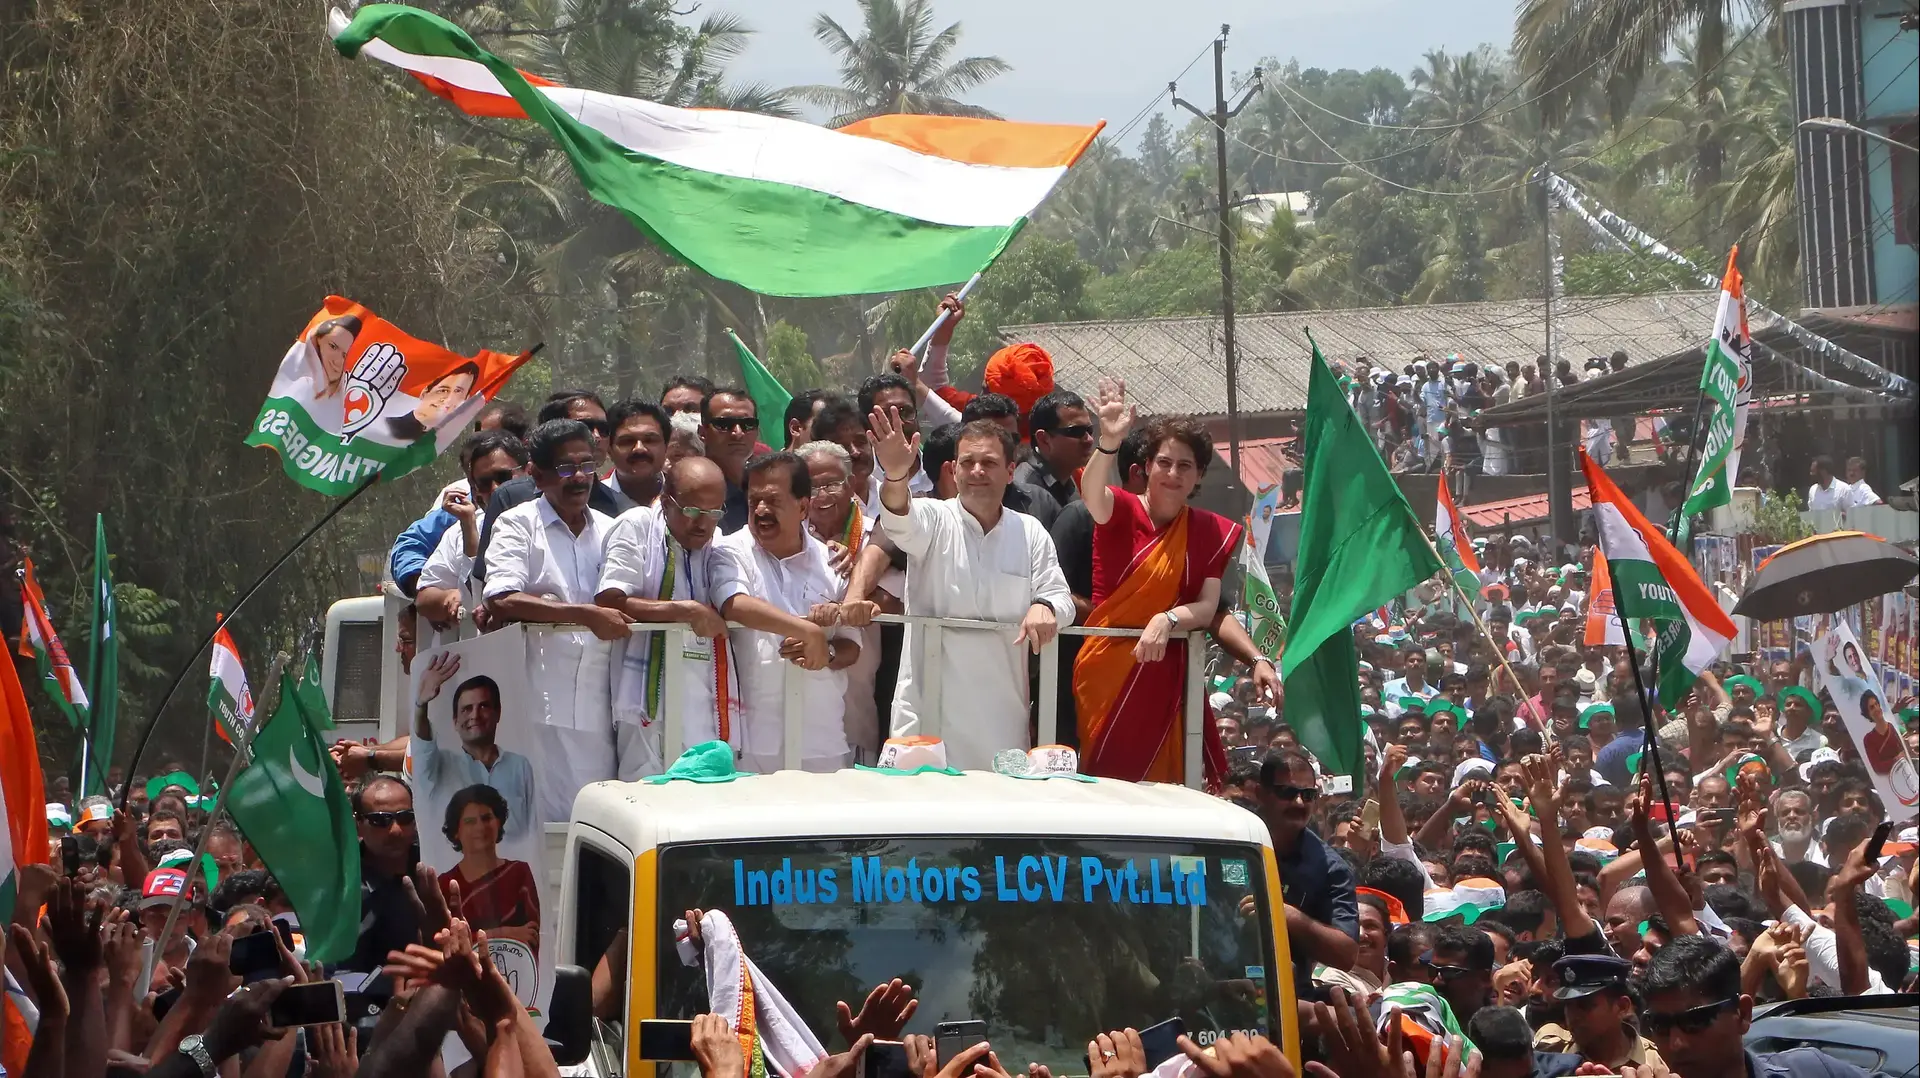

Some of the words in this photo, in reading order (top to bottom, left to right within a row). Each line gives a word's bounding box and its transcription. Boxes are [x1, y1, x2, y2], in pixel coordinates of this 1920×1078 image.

[1708, 362, 1738, 416] YOUT
[218, 699, 237, 728] YOUTH
[733, 857, 839, 906] Indus
[851, 855, 982, 904] Motors
[994, 855, 1068, 903] LCV
[1081, 856, 1207, 906] Pvt.Ltd
